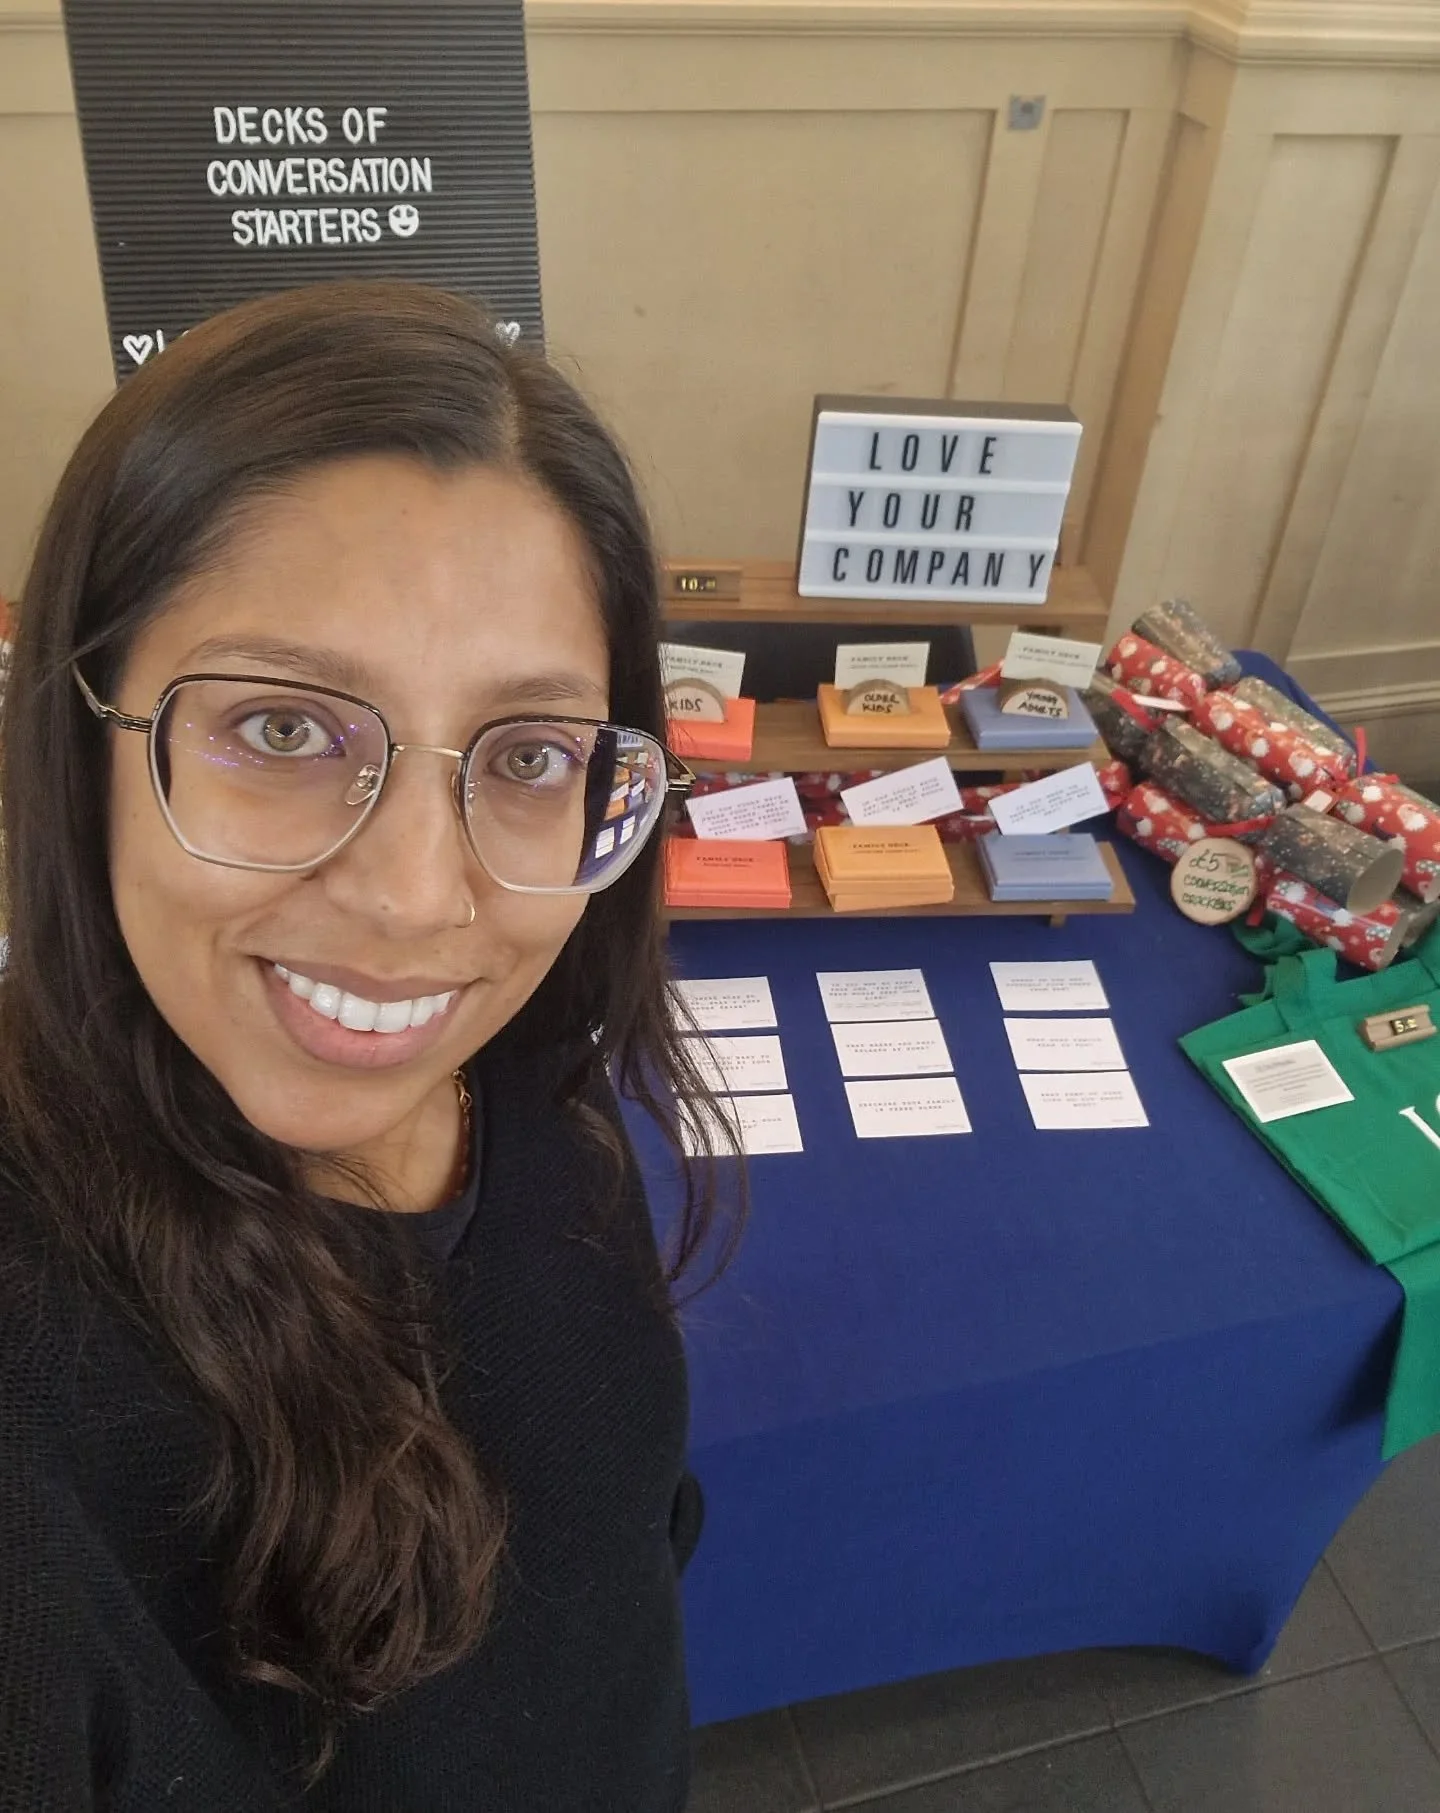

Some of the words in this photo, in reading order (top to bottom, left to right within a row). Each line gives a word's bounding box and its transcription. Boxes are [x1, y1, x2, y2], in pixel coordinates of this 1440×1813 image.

[213, 106, 328, 144] DECKS
[342, 106, 387, 144] OF
[206, 157, 433, 196] CONVERSATION
[231, 207, 383, 246] STARTERS
[868, 431, 997, 475] LOVE
[848, 490, 975, 532] YOUR
[832, 547, 1045, 588] COMPANY
[668, 697, 704, 713] KIDS
[862, 702, 893, 714] KIDS
[863, 693, 900, 704] OLDER
[1018, 701, 1063, 717] ADULTS
